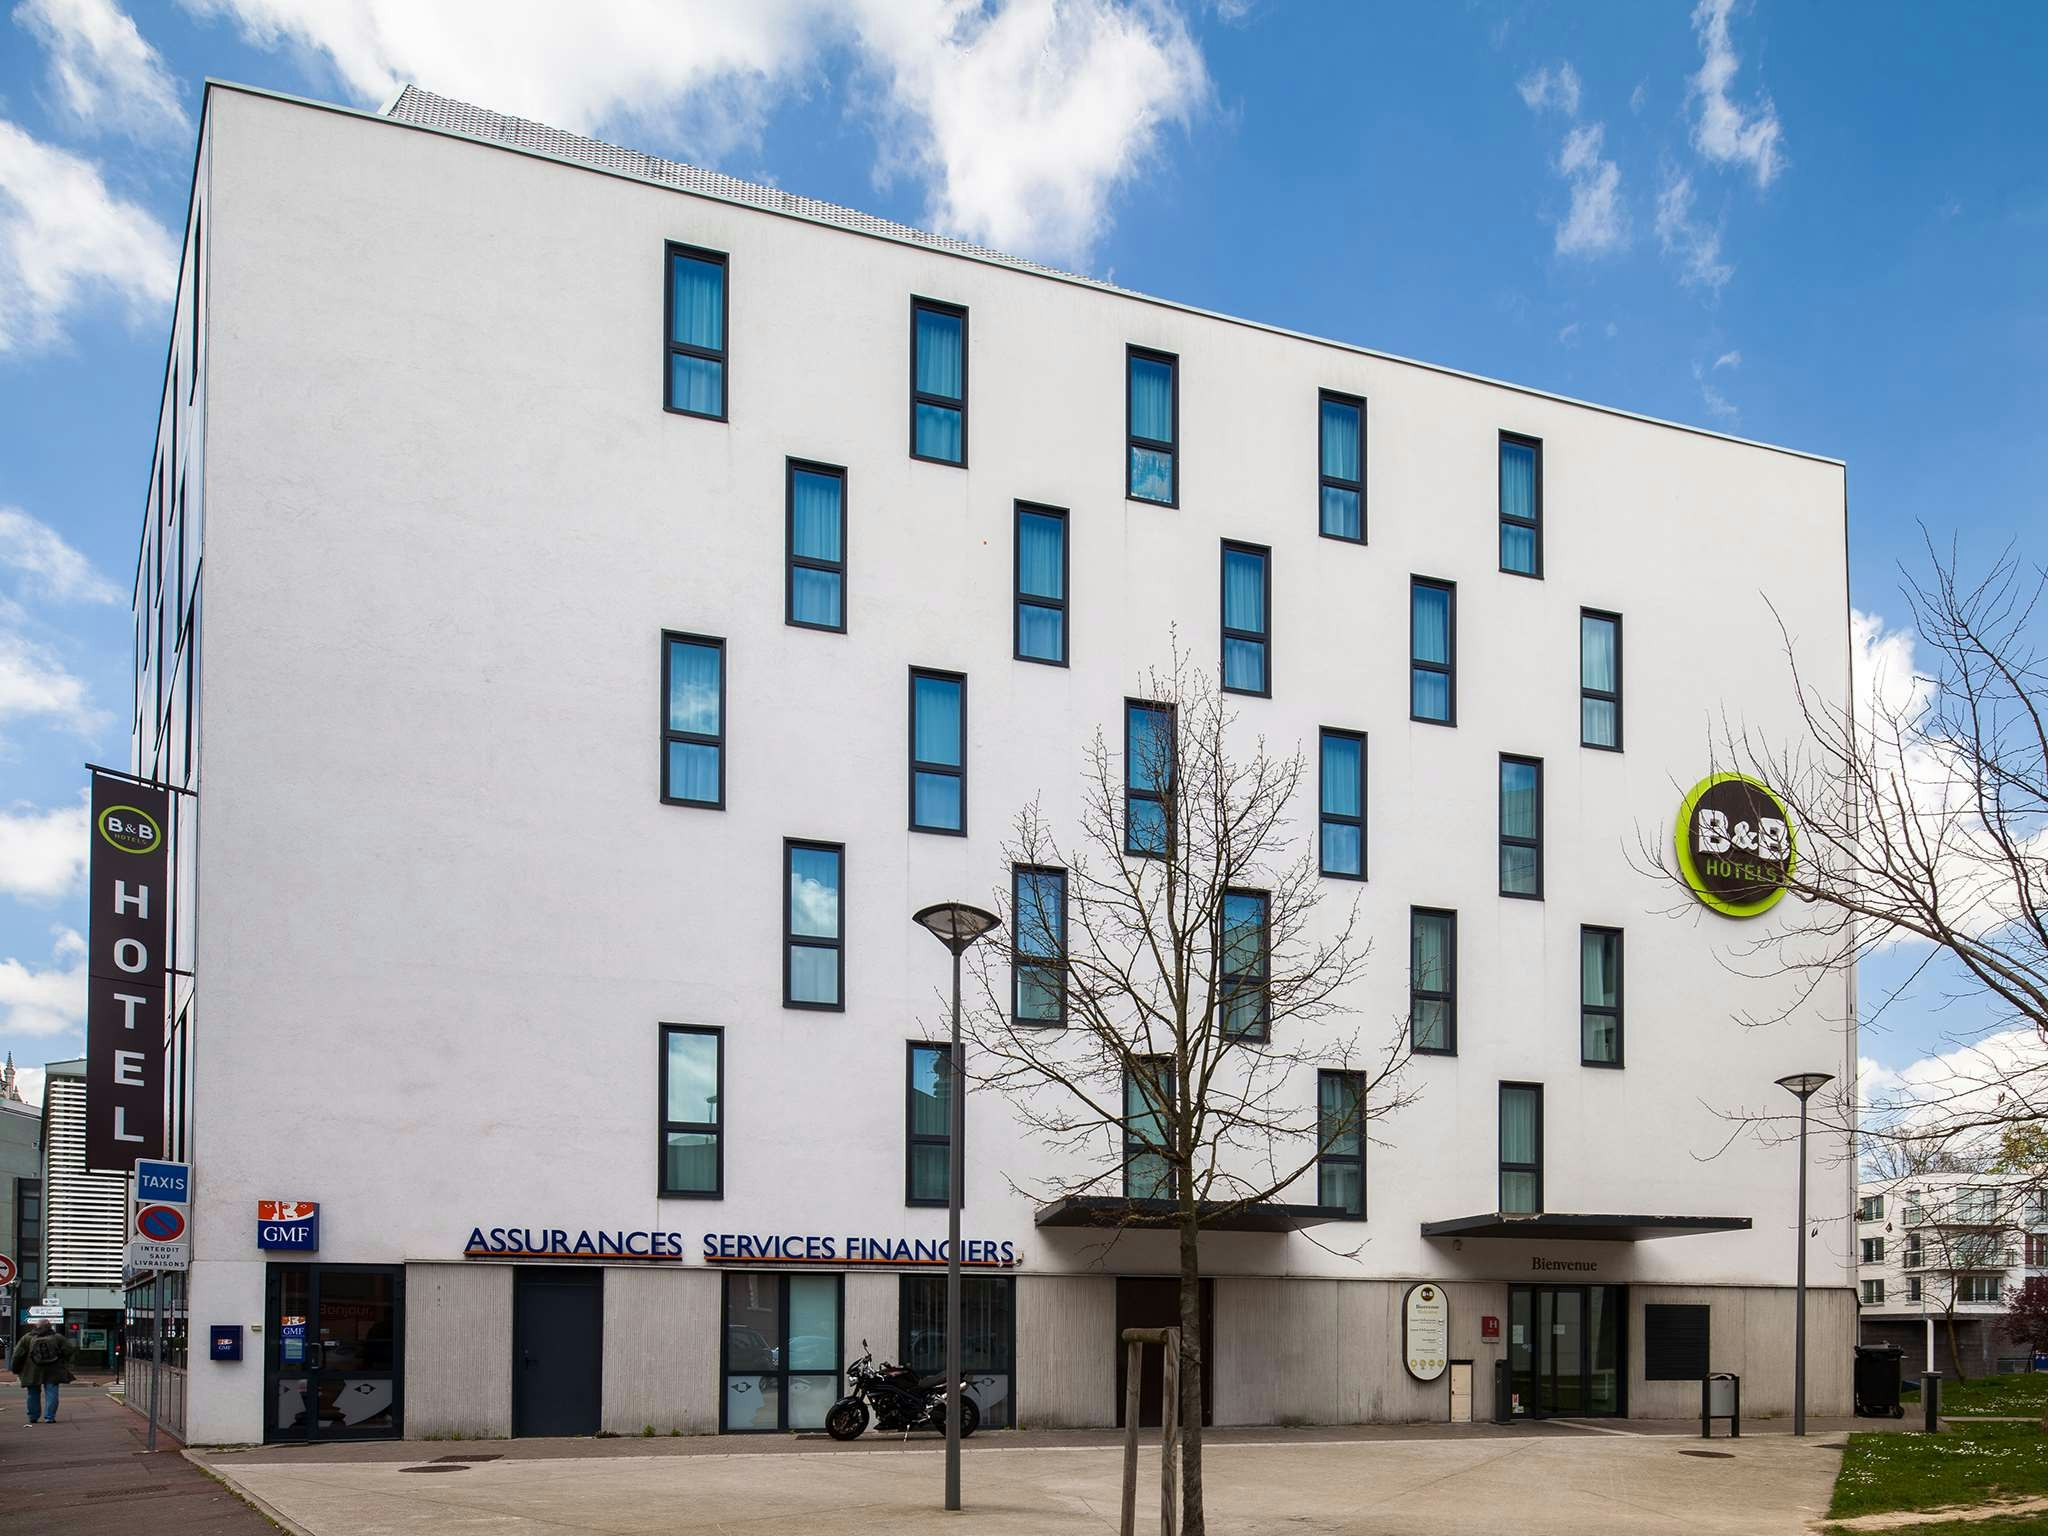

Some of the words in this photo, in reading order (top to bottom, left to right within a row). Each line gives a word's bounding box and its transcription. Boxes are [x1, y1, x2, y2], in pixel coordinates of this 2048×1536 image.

[108, 816, 154, 840] B&B
[1698, 808, 1791, 861] B&B
[1706, 858, 1778, 883] HOTELS
[113, 879, 149, 1143] HOTEL
[142, 1175, 185, 1190] TAXIS
[263, 1226, 310, 1243] GMF
[140, 1245, 180, 1253] INTERDIT
[464, 1227, 682, 1257] ASSURANCES
[703, 1233, 836, 1259] SERVICES
[846, 1237, 1014, 1263] FINANCIERS
[134, 1260, 185, 1268] LIVRAISONS
[1531, 1256, 1598, 1272] Bienvenue
[1489, 1319, 1497, 1328] H
[282, 1327, 305, 1337] GMF
